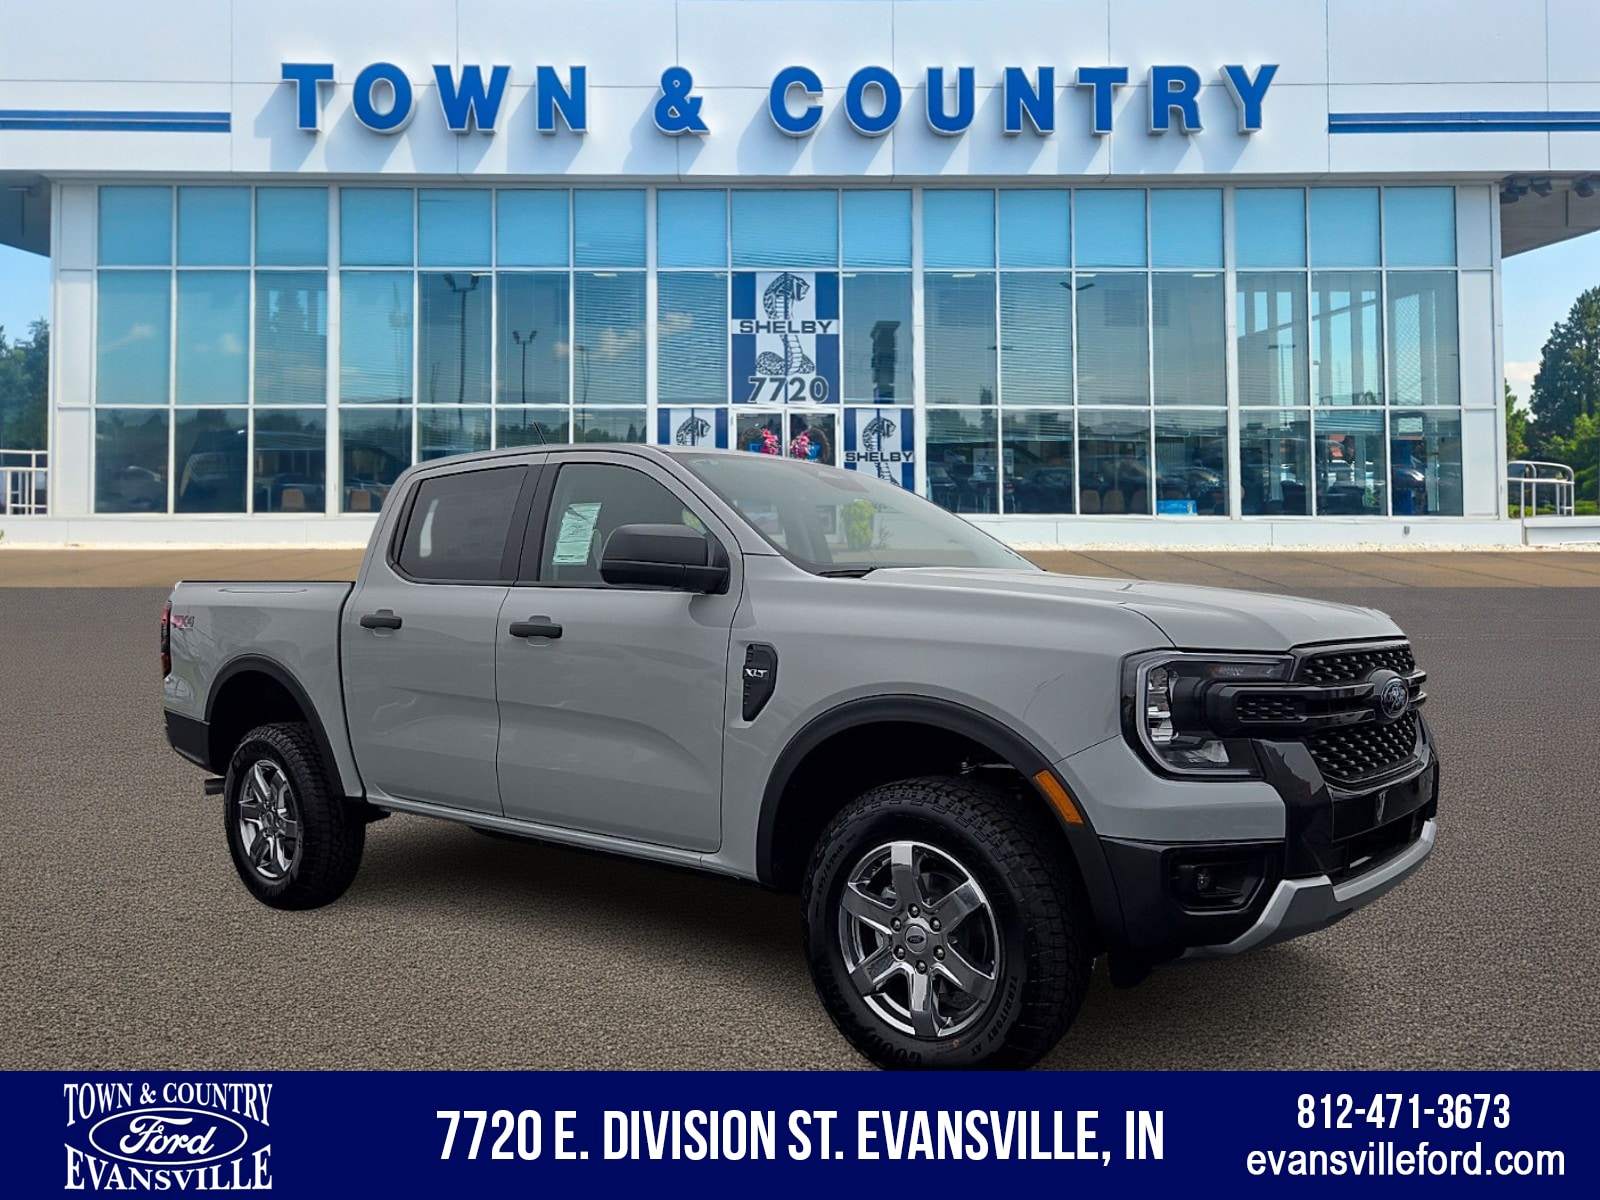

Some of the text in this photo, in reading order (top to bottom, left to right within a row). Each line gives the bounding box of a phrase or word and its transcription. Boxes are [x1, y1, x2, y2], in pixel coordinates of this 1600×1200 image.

[281, 62, 1279, 136] TOWN & COUNTRY
[739, 320, 833, 334] SHELBY
[749, 376, 829, 402] 7720
[845, 451, 914, 462] SHELBY
[745, 668, 769, 678] XLT
[987, 976, 1018, 1044] TERRITORY
